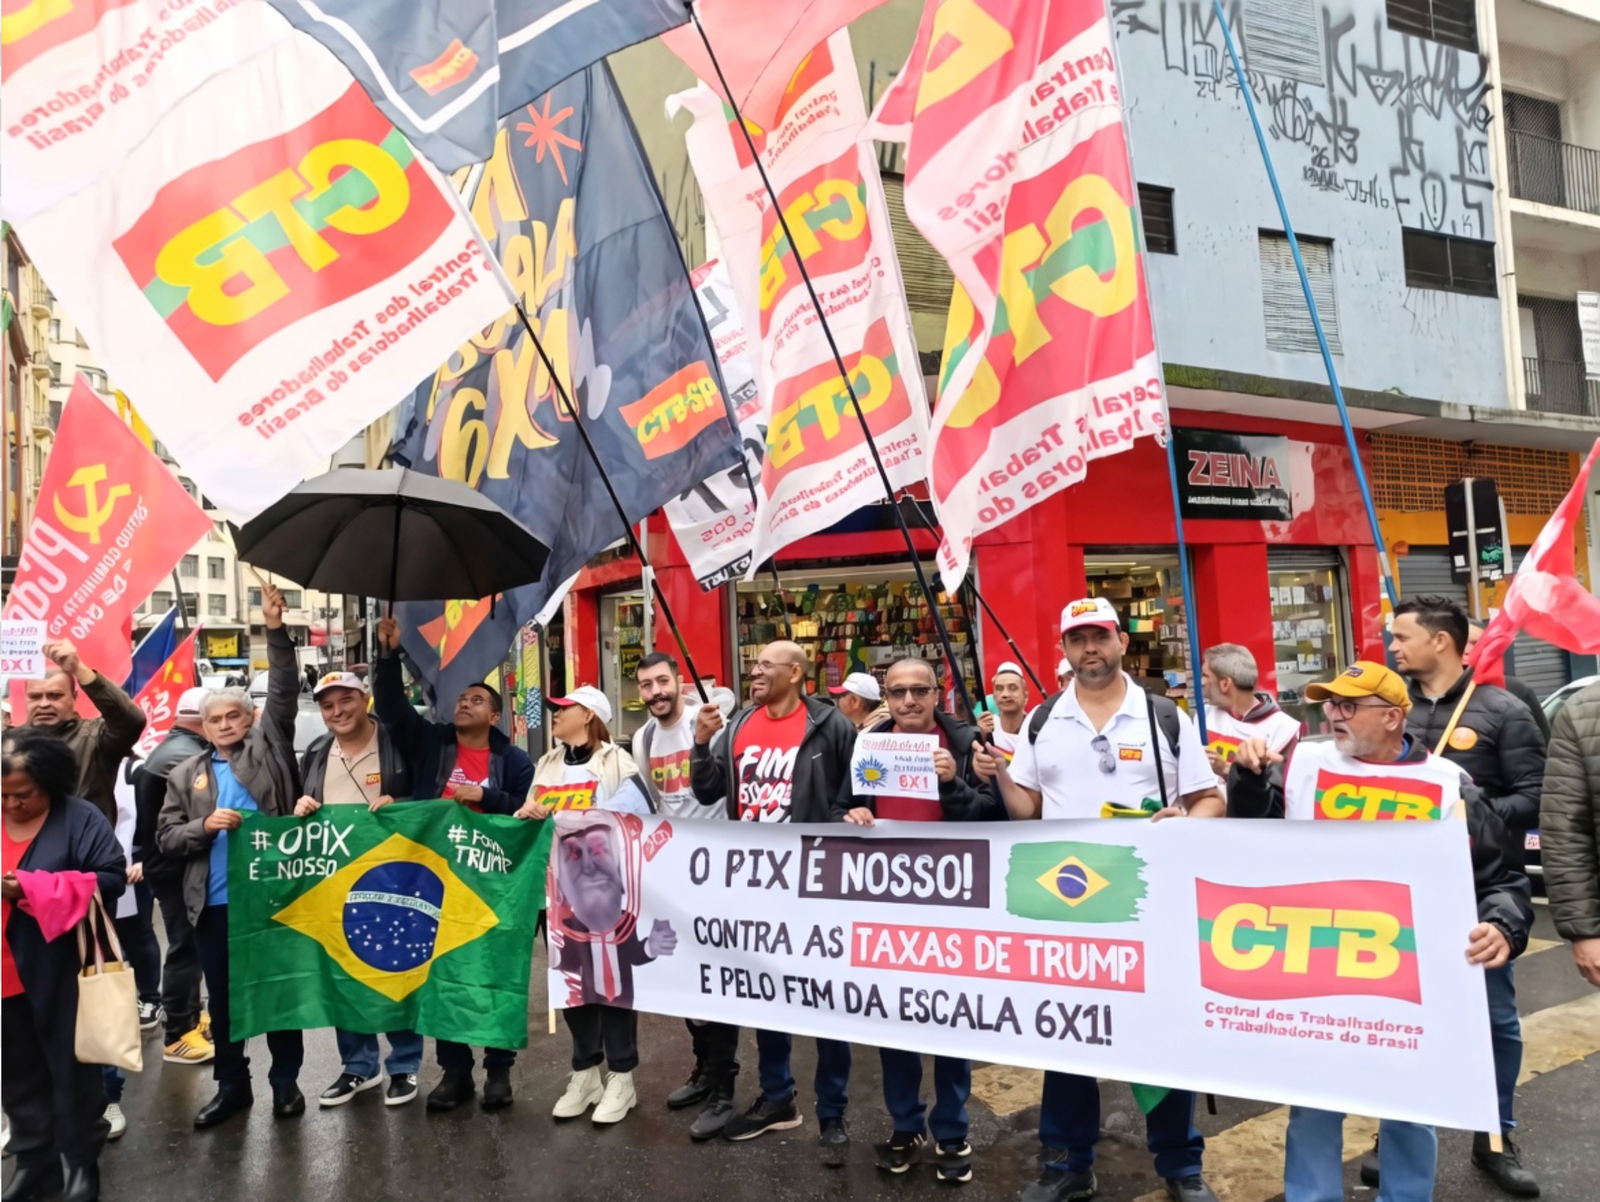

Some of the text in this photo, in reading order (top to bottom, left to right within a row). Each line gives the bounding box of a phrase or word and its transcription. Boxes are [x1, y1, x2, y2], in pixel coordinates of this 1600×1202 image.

[1188, 449, 1282, 489] ZEINA
[739, 745, 800, 781] FIM
[537, 789, 593, 811] CTB
[1320, 783, 1436, 820] CTB
[249, 856, 338, 880] É NOSSO
[455, 844, 513, 875] TRUMP
[689, 837, 973, 900] O PIX É NOSSO!
[693, 916, 1138, 984] CONTRA AS TAXAS DE TRUMP
[1210, 902, 1401, 980] CTB
[700, 964, 1113, 1047] E PELO FIM DA ESCALA 6X1!
[1266, 1008, 1294, 1022] dos
[1299, 1010, 1424, 1036] Trabalhadores
[1219, 1017, 1334, 1041] Trabalhadoras
[1339, 1030, 1361, 1044] do
[1367, 1033, 1418, 1051] Brasil
